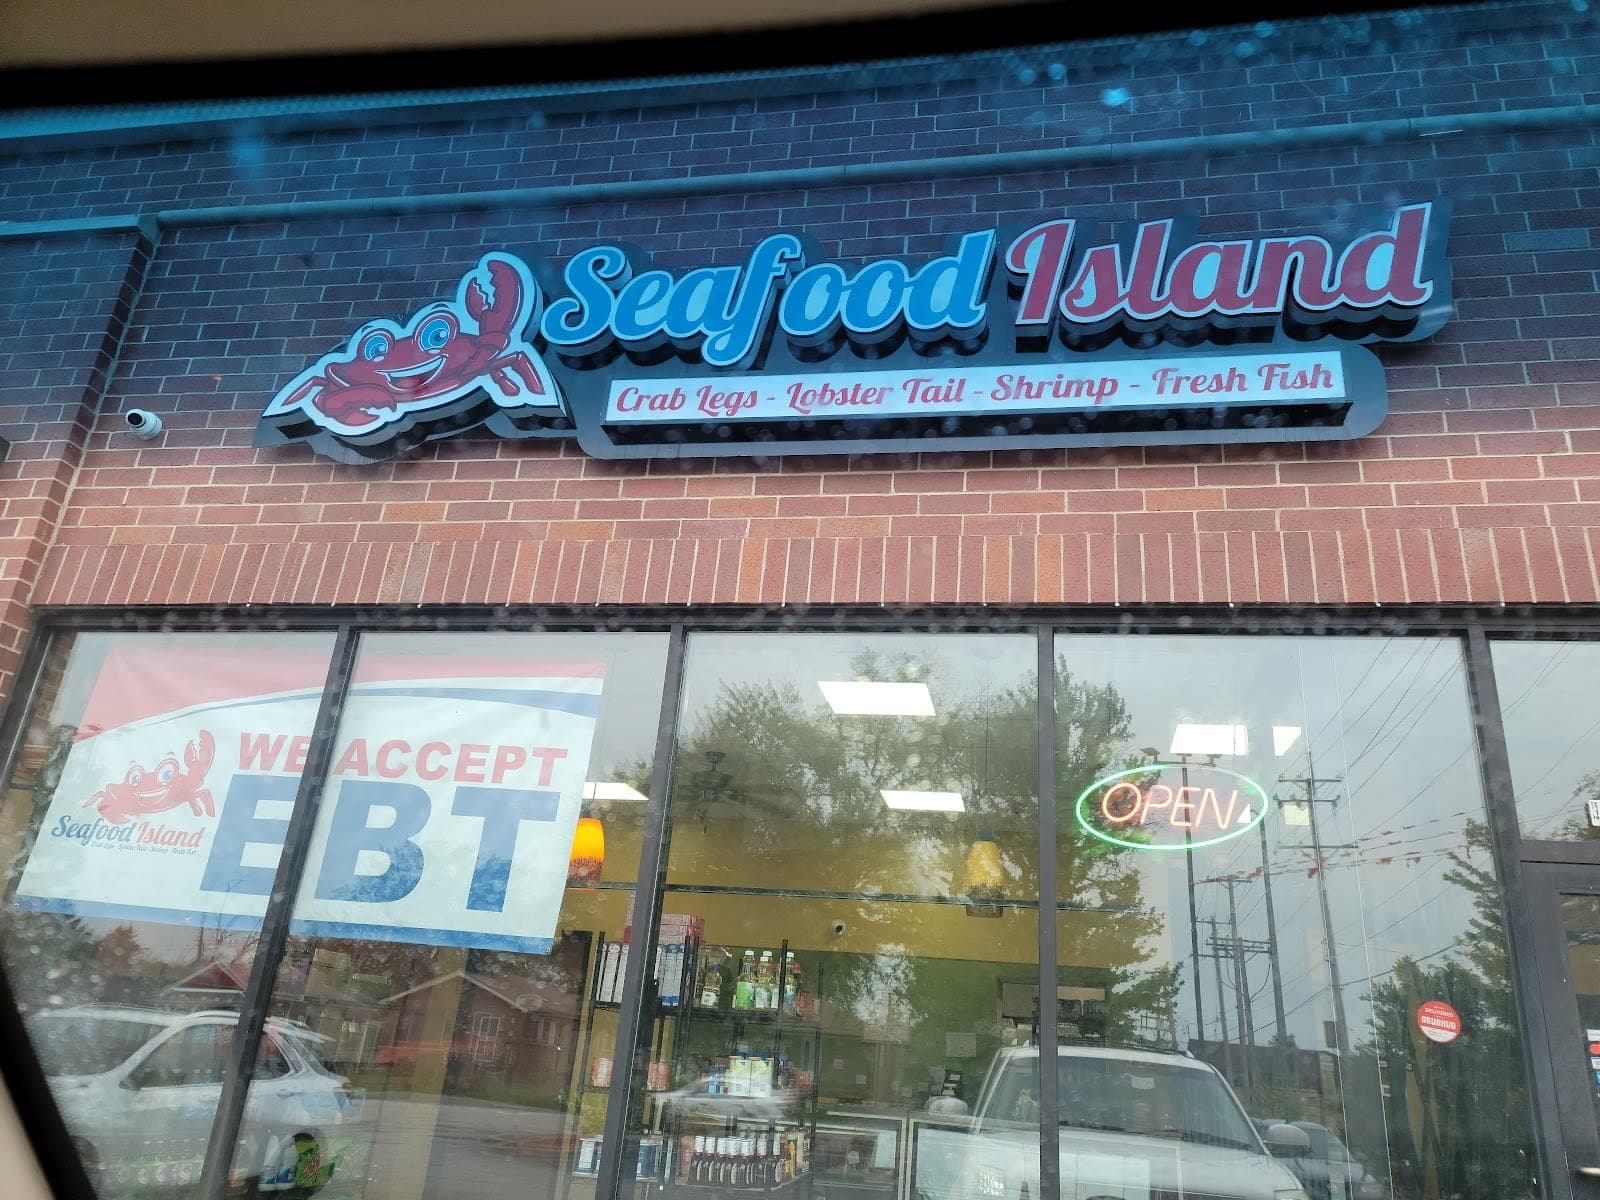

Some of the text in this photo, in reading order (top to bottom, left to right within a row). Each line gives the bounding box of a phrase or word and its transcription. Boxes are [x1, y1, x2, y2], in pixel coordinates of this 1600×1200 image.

[541, 202, 1433, 366] Seafood Island
[616, 387, 686, 412] Crab
[696, 384, 757, 417] Legs
[786, 382, 893, 415] Lobster
[902, 378, 966, 403] Tail
[990, 373, 1118, 405] Shrimp
[1152, 367, 1248, 395] Fresh
[1257, 363, 1333, 389] Fish
[239, 732, 568, 786] WE ACCEPT
[51, 815, 205, 848] Seafood Island
[1102, 782, 1237, 829] OPEN
[199, 774, 560, 913] EBT
